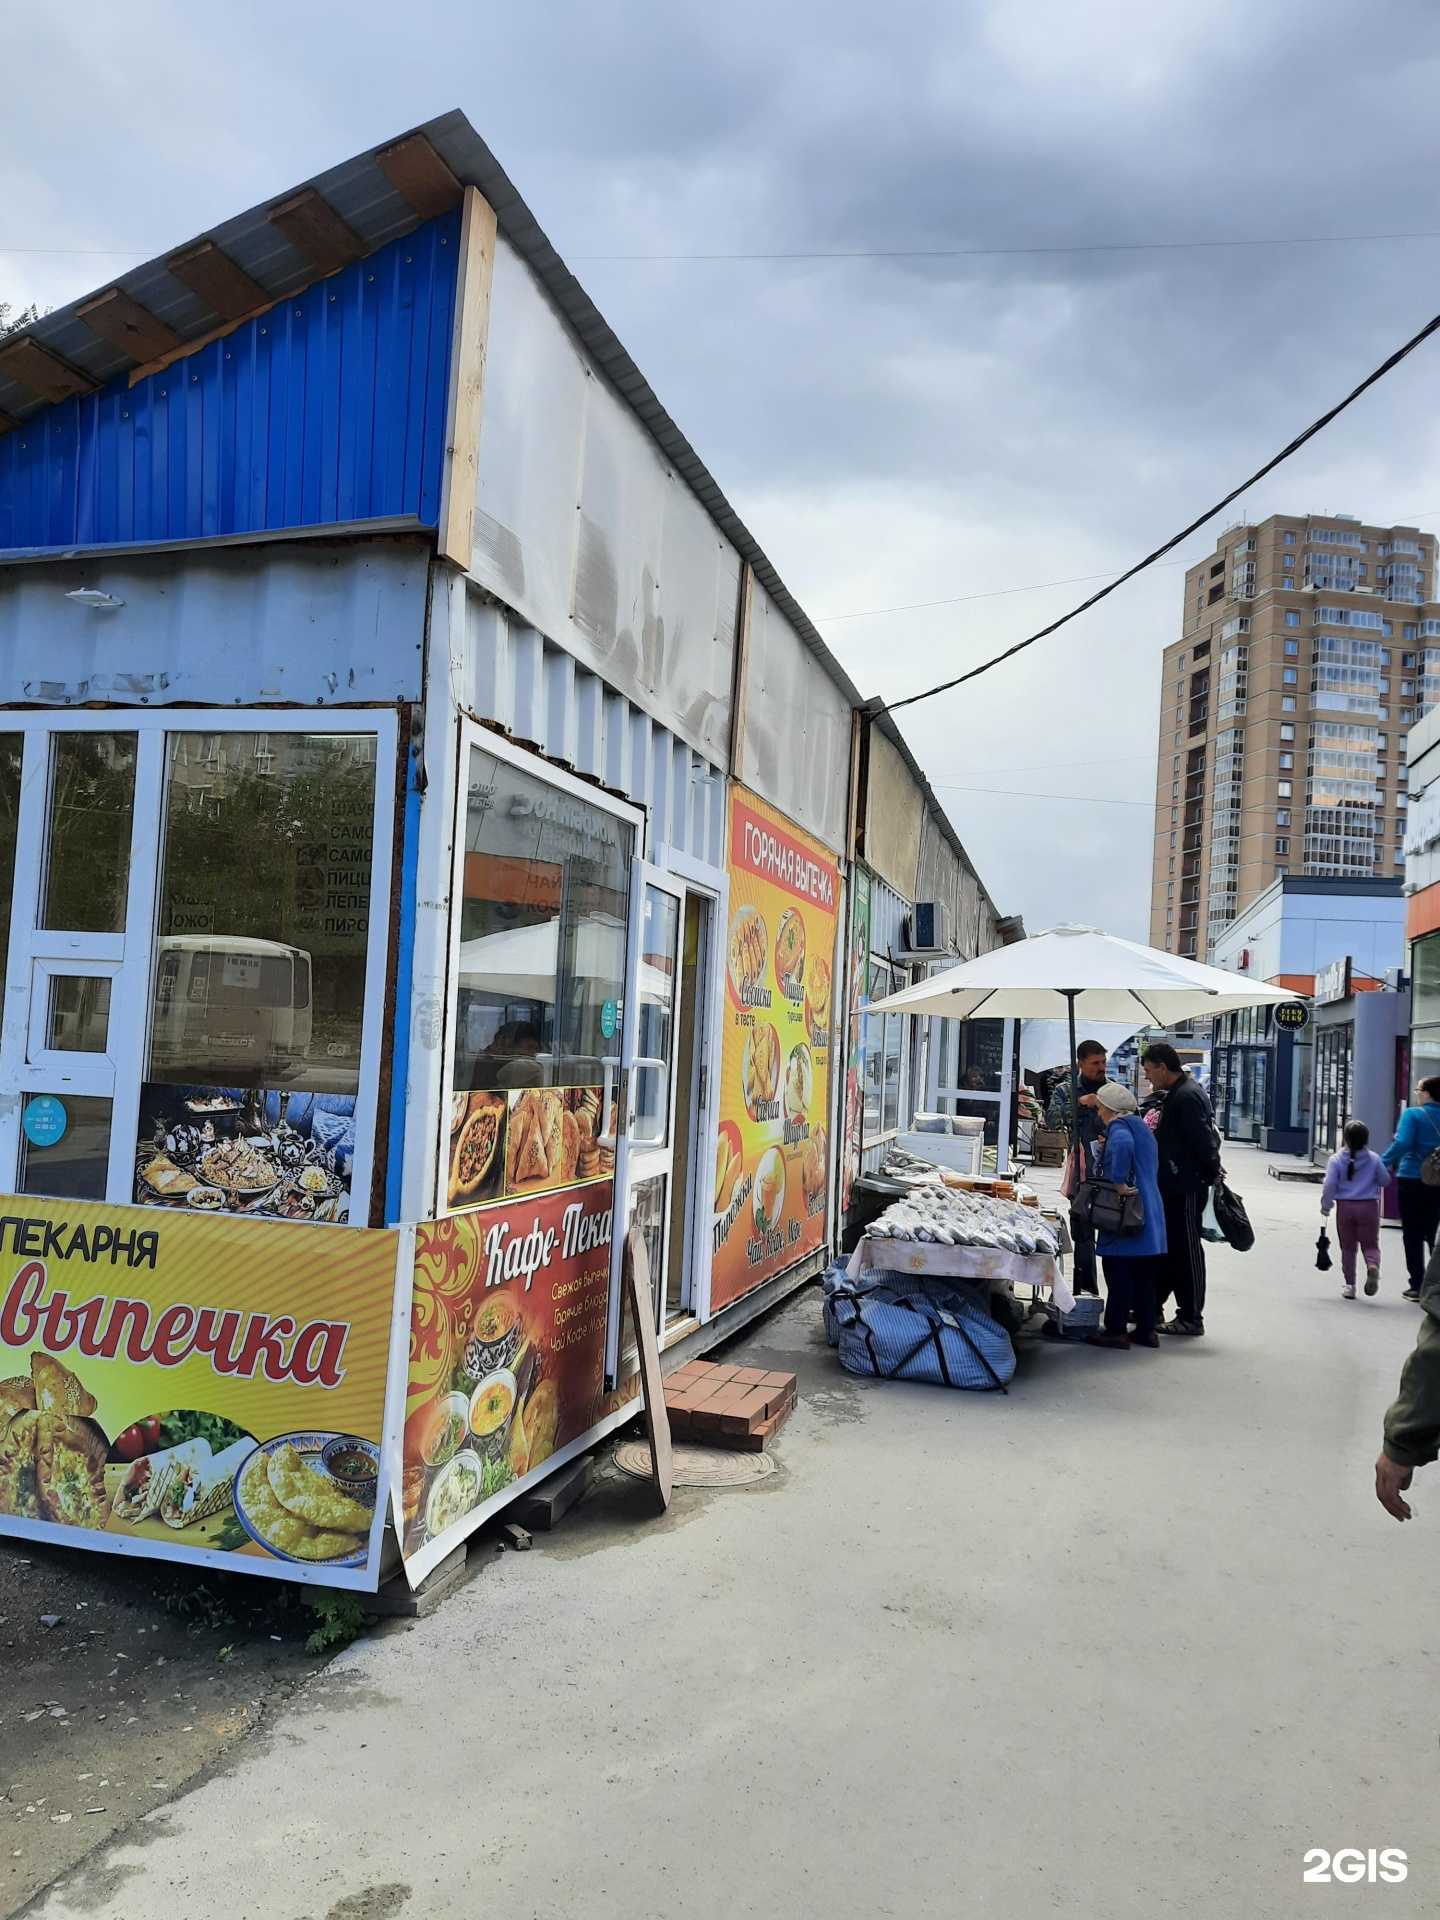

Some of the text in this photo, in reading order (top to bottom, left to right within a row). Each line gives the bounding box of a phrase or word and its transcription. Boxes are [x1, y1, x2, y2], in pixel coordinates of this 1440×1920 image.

[743, 819, 834, 906] ГОРЯЧАЯ ВЫПЕЧКА
[0, 1216, 160, 1269] ПЕКАРНЯ
[551, 1276, 582, 1301] Свежая
[0, 1259, 352, 1390] выпечка
